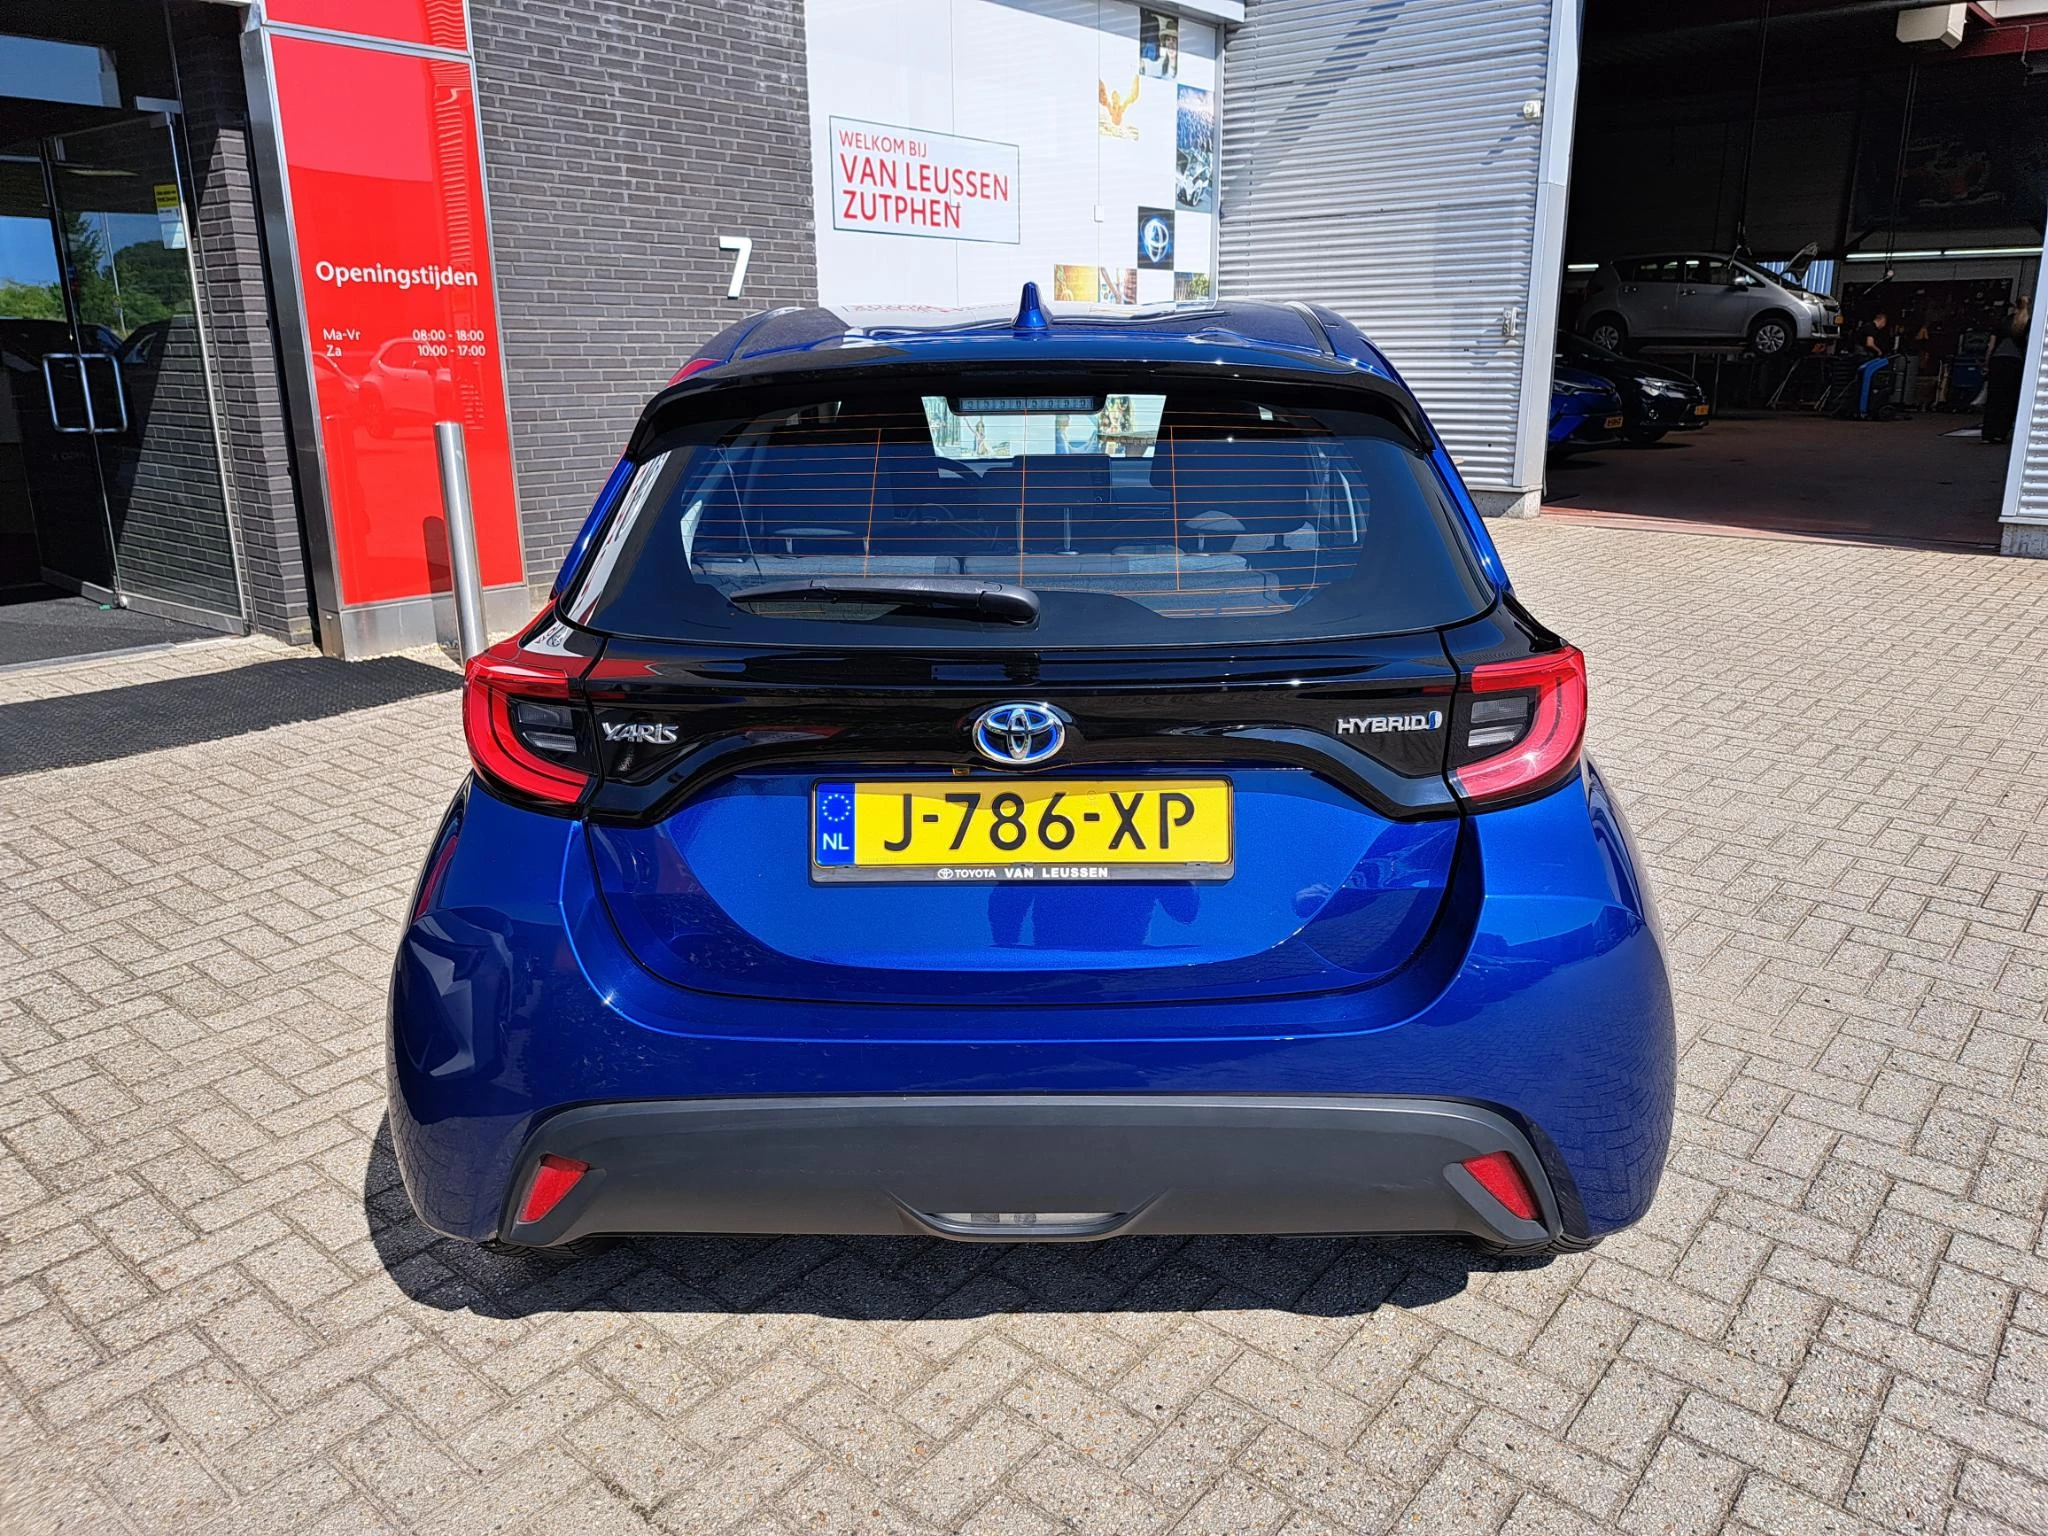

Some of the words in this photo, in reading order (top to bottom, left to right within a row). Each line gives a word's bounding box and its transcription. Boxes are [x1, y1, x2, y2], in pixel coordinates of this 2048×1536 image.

[838, 129, 906, 155] WELKOM
[908, 140, 928, 158] BIJ
[839, 152, 897, 189] VAN
[905, 161, 1009, 202] LEUSSEN
[842, 189, 962, 229] ZUTPHEN
[315, 260, 479, 291] Openingstijden
[719, 235, 753, 299] 7
[322, 328, 361, 341] Ma-Vr
[412, 329, 446, 342] 08:00
[456, 329, 485, 342] 18:00
[326, 345, 343, 357] Za
[416, 345, 448, 357] 10:00
[457, 345, 486, 357] 17:00
[601, 722, 680, 744] YARIS
[1336, 714, 1429, 735] HYBRID
[883, 792, 1195, 852] J-786-XP
[822, 832, 850, 850] NL
[954, 868, 997, 879] TOYOTA
[1003, 867, 1034, 879] VAN
[1041, 867, 1109, 879] LEUSSEN
